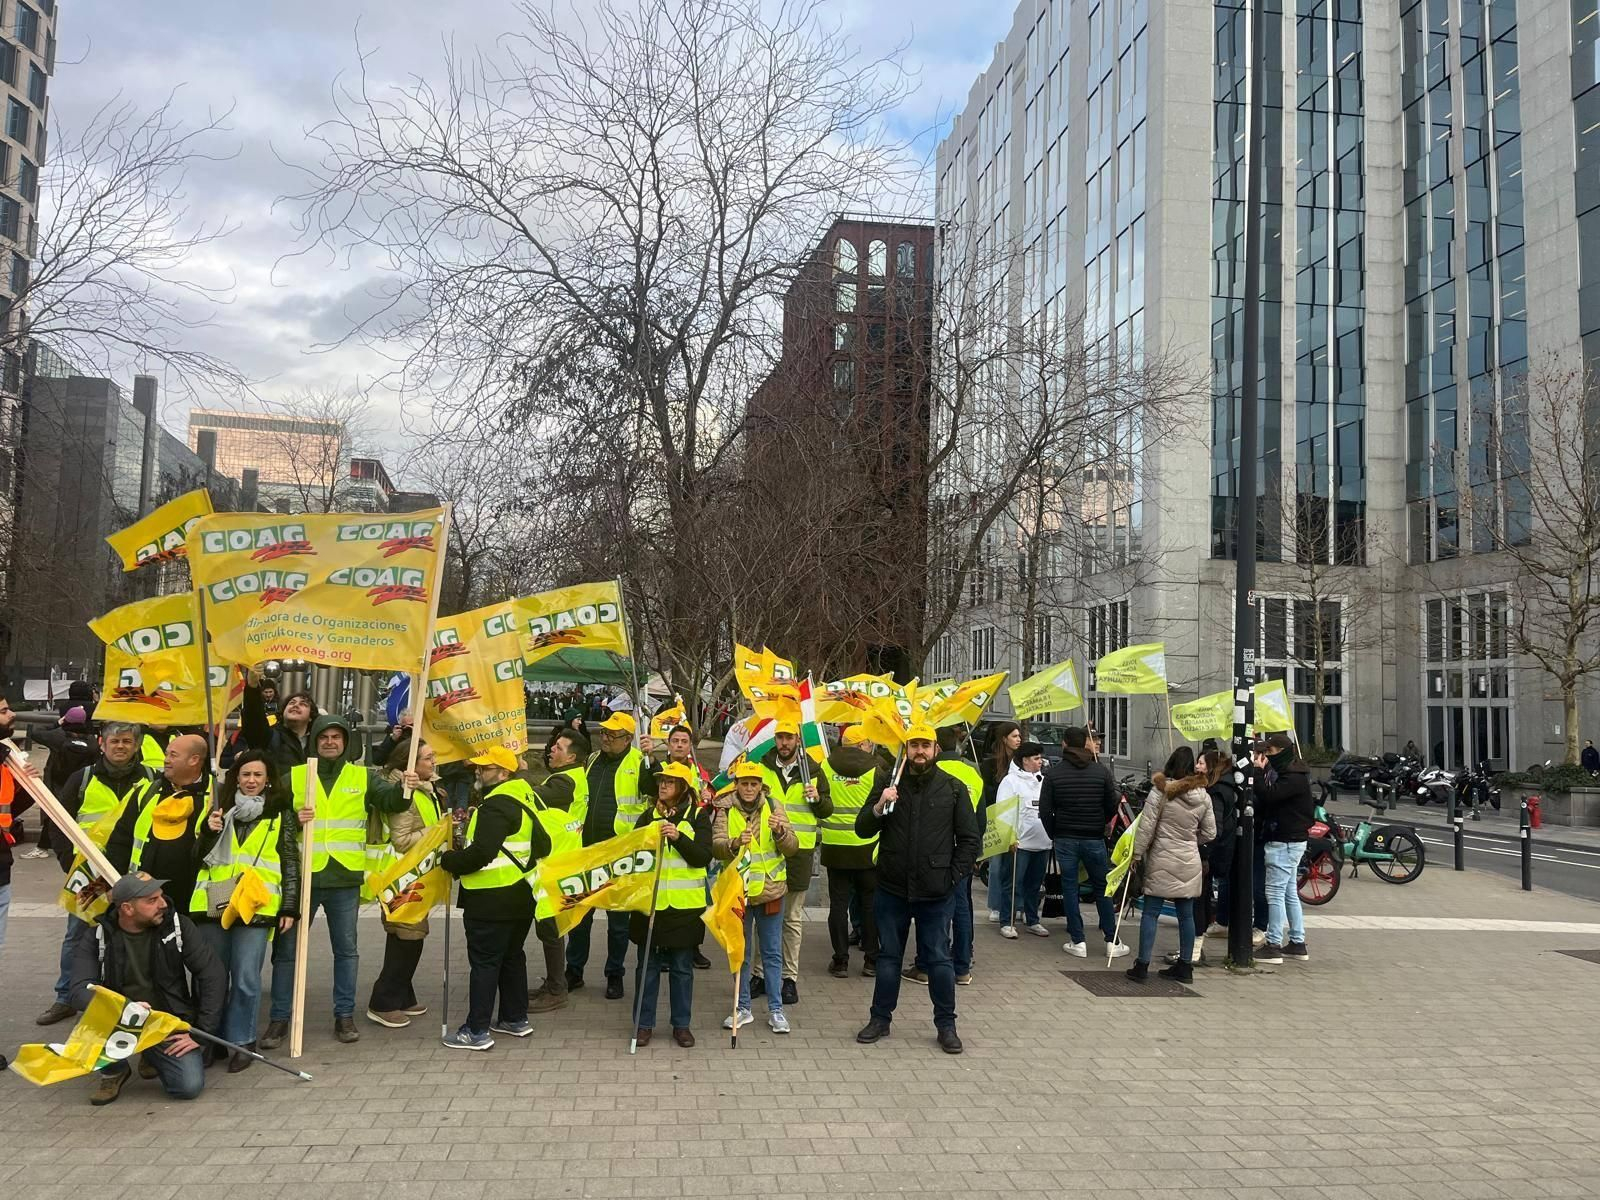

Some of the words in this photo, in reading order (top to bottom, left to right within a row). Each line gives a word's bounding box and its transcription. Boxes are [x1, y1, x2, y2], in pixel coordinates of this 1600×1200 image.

[204, 525, 305, 553] COAG
[339, 522, 433, 541] COAG
[211, 571, 306, 601] COAG
[329, 567, 422, 588] COAG
[293, 612, 309, 625] de
[312, 615, 408, 633] Organizaciones
[247, 625, 313, 645] Agricultores
[317, 634, 324, 644] y
[327, 633, 395, 647] Ganaderos
[485, 714, 497, 725] de
[505, 726, 512, 737] y
